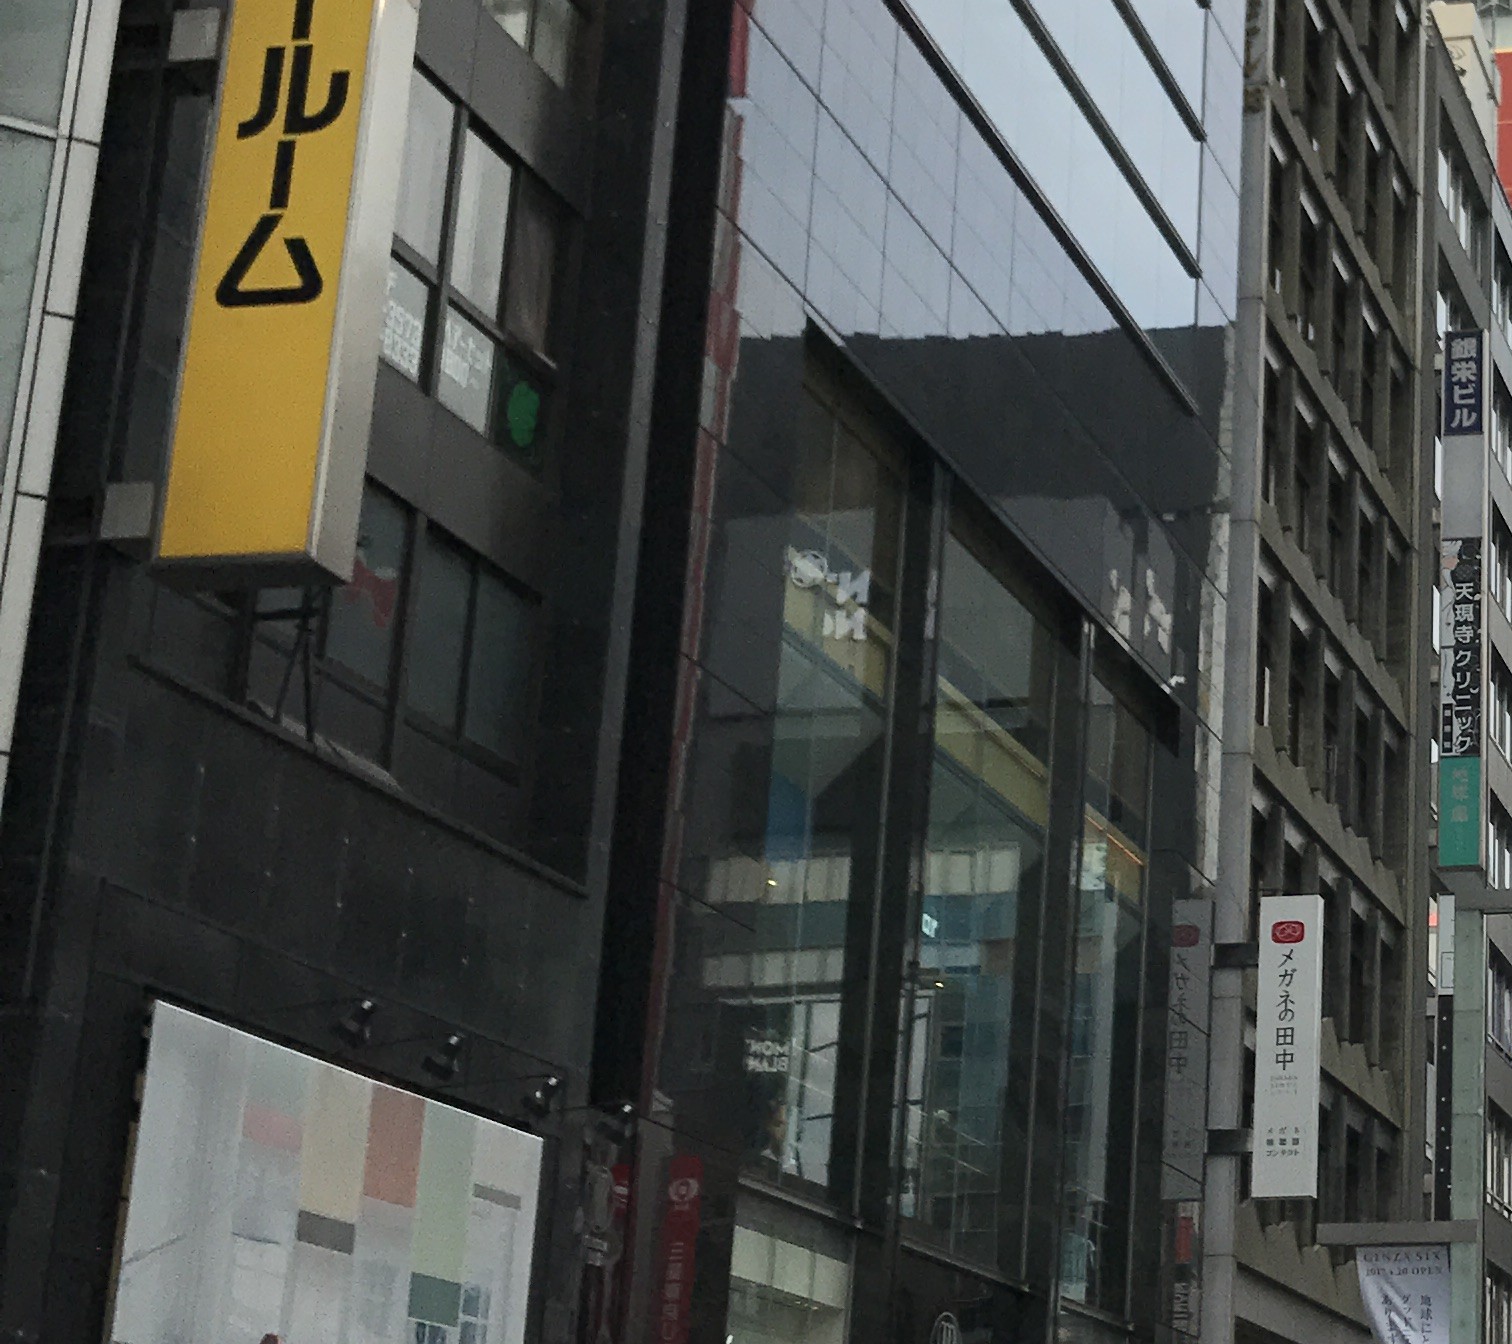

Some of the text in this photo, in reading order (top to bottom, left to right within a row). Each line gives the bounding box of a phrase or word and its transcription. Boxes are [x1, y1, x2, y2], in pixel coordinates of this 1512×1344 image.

[1450, 337, 1478, 428] 銀栄ビル
[1455, 582, 1474, 753] 天現寺クリニック
[1275, 948, 1298, 1071] メガネの田中
